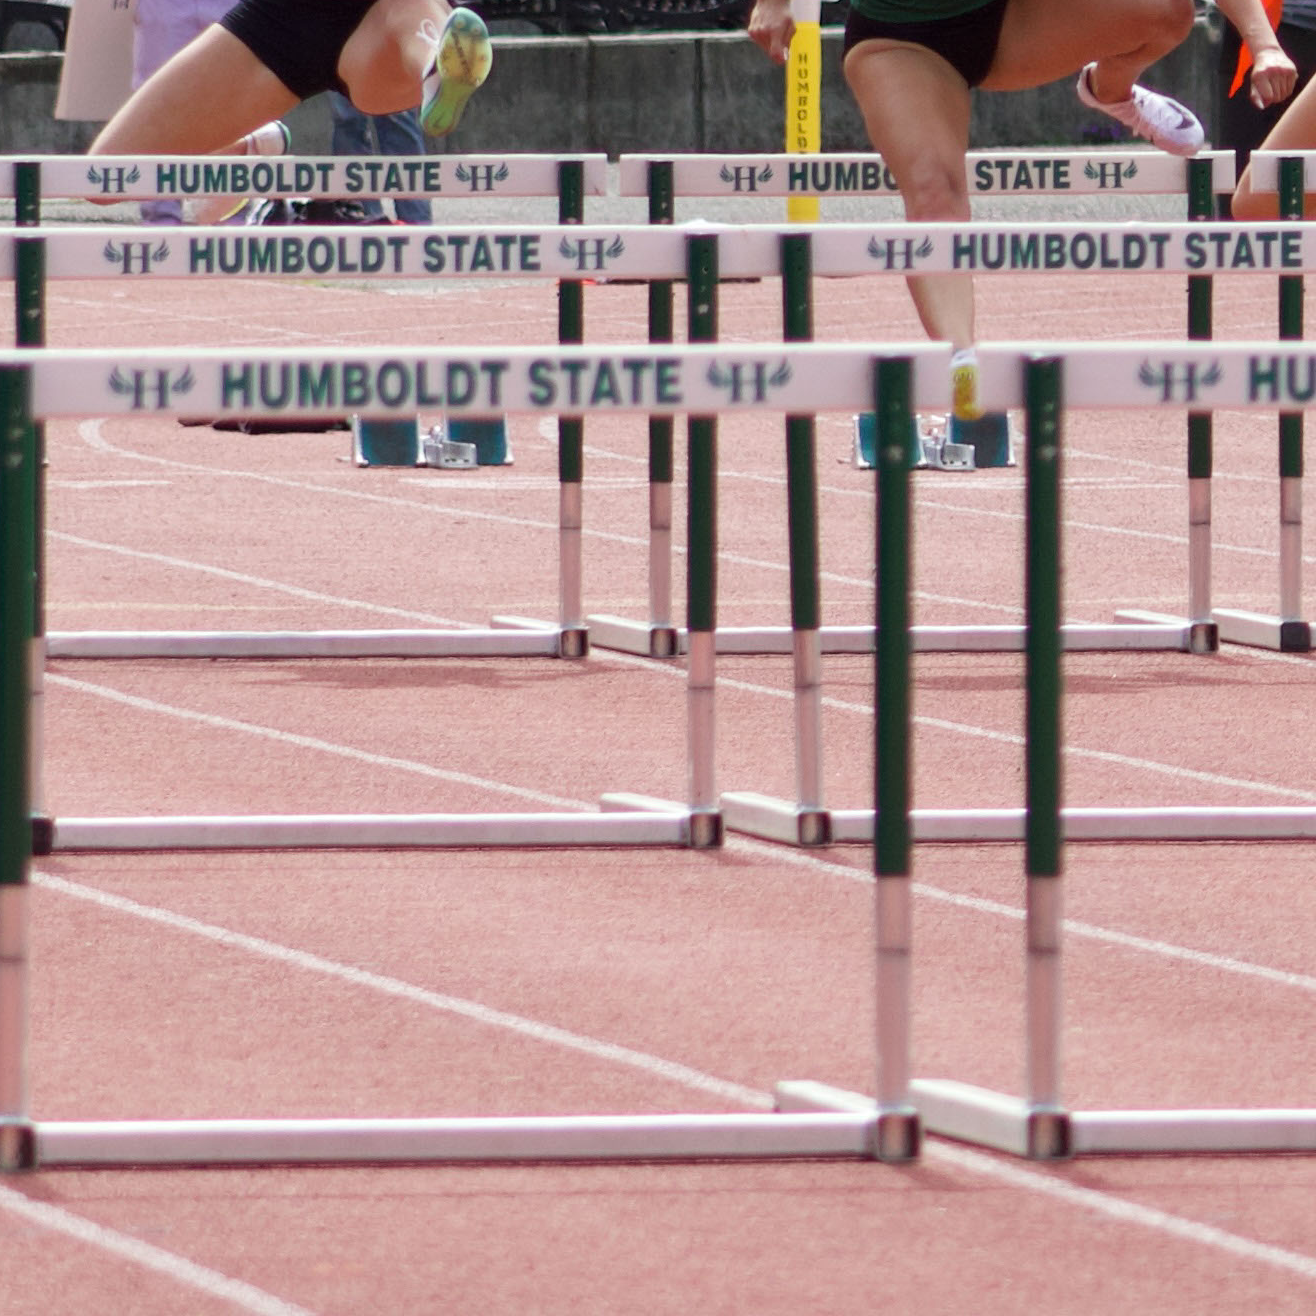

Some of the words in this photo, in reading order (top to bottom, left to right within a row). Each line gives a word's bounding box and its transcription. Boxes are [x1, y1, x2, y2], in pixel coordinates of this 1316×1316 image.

[796, 52, 810, 154] HUMBOLD
[156, 162, 335, 194] HUMBOLDT
[345, 161, 441, 193] STATE
[975, 159, 1071, 191] STATE
[189, 236, 409, 274] HUMBOLDT
[423, 235, 541, 274] STATE
[952, 232, 1171, 270] HUMBOLDT
[1184, 230, 1303, 270] STATE
[221, 360, 509, 410] HUMBOLDT
[528, 358, 682, 407] STATE
